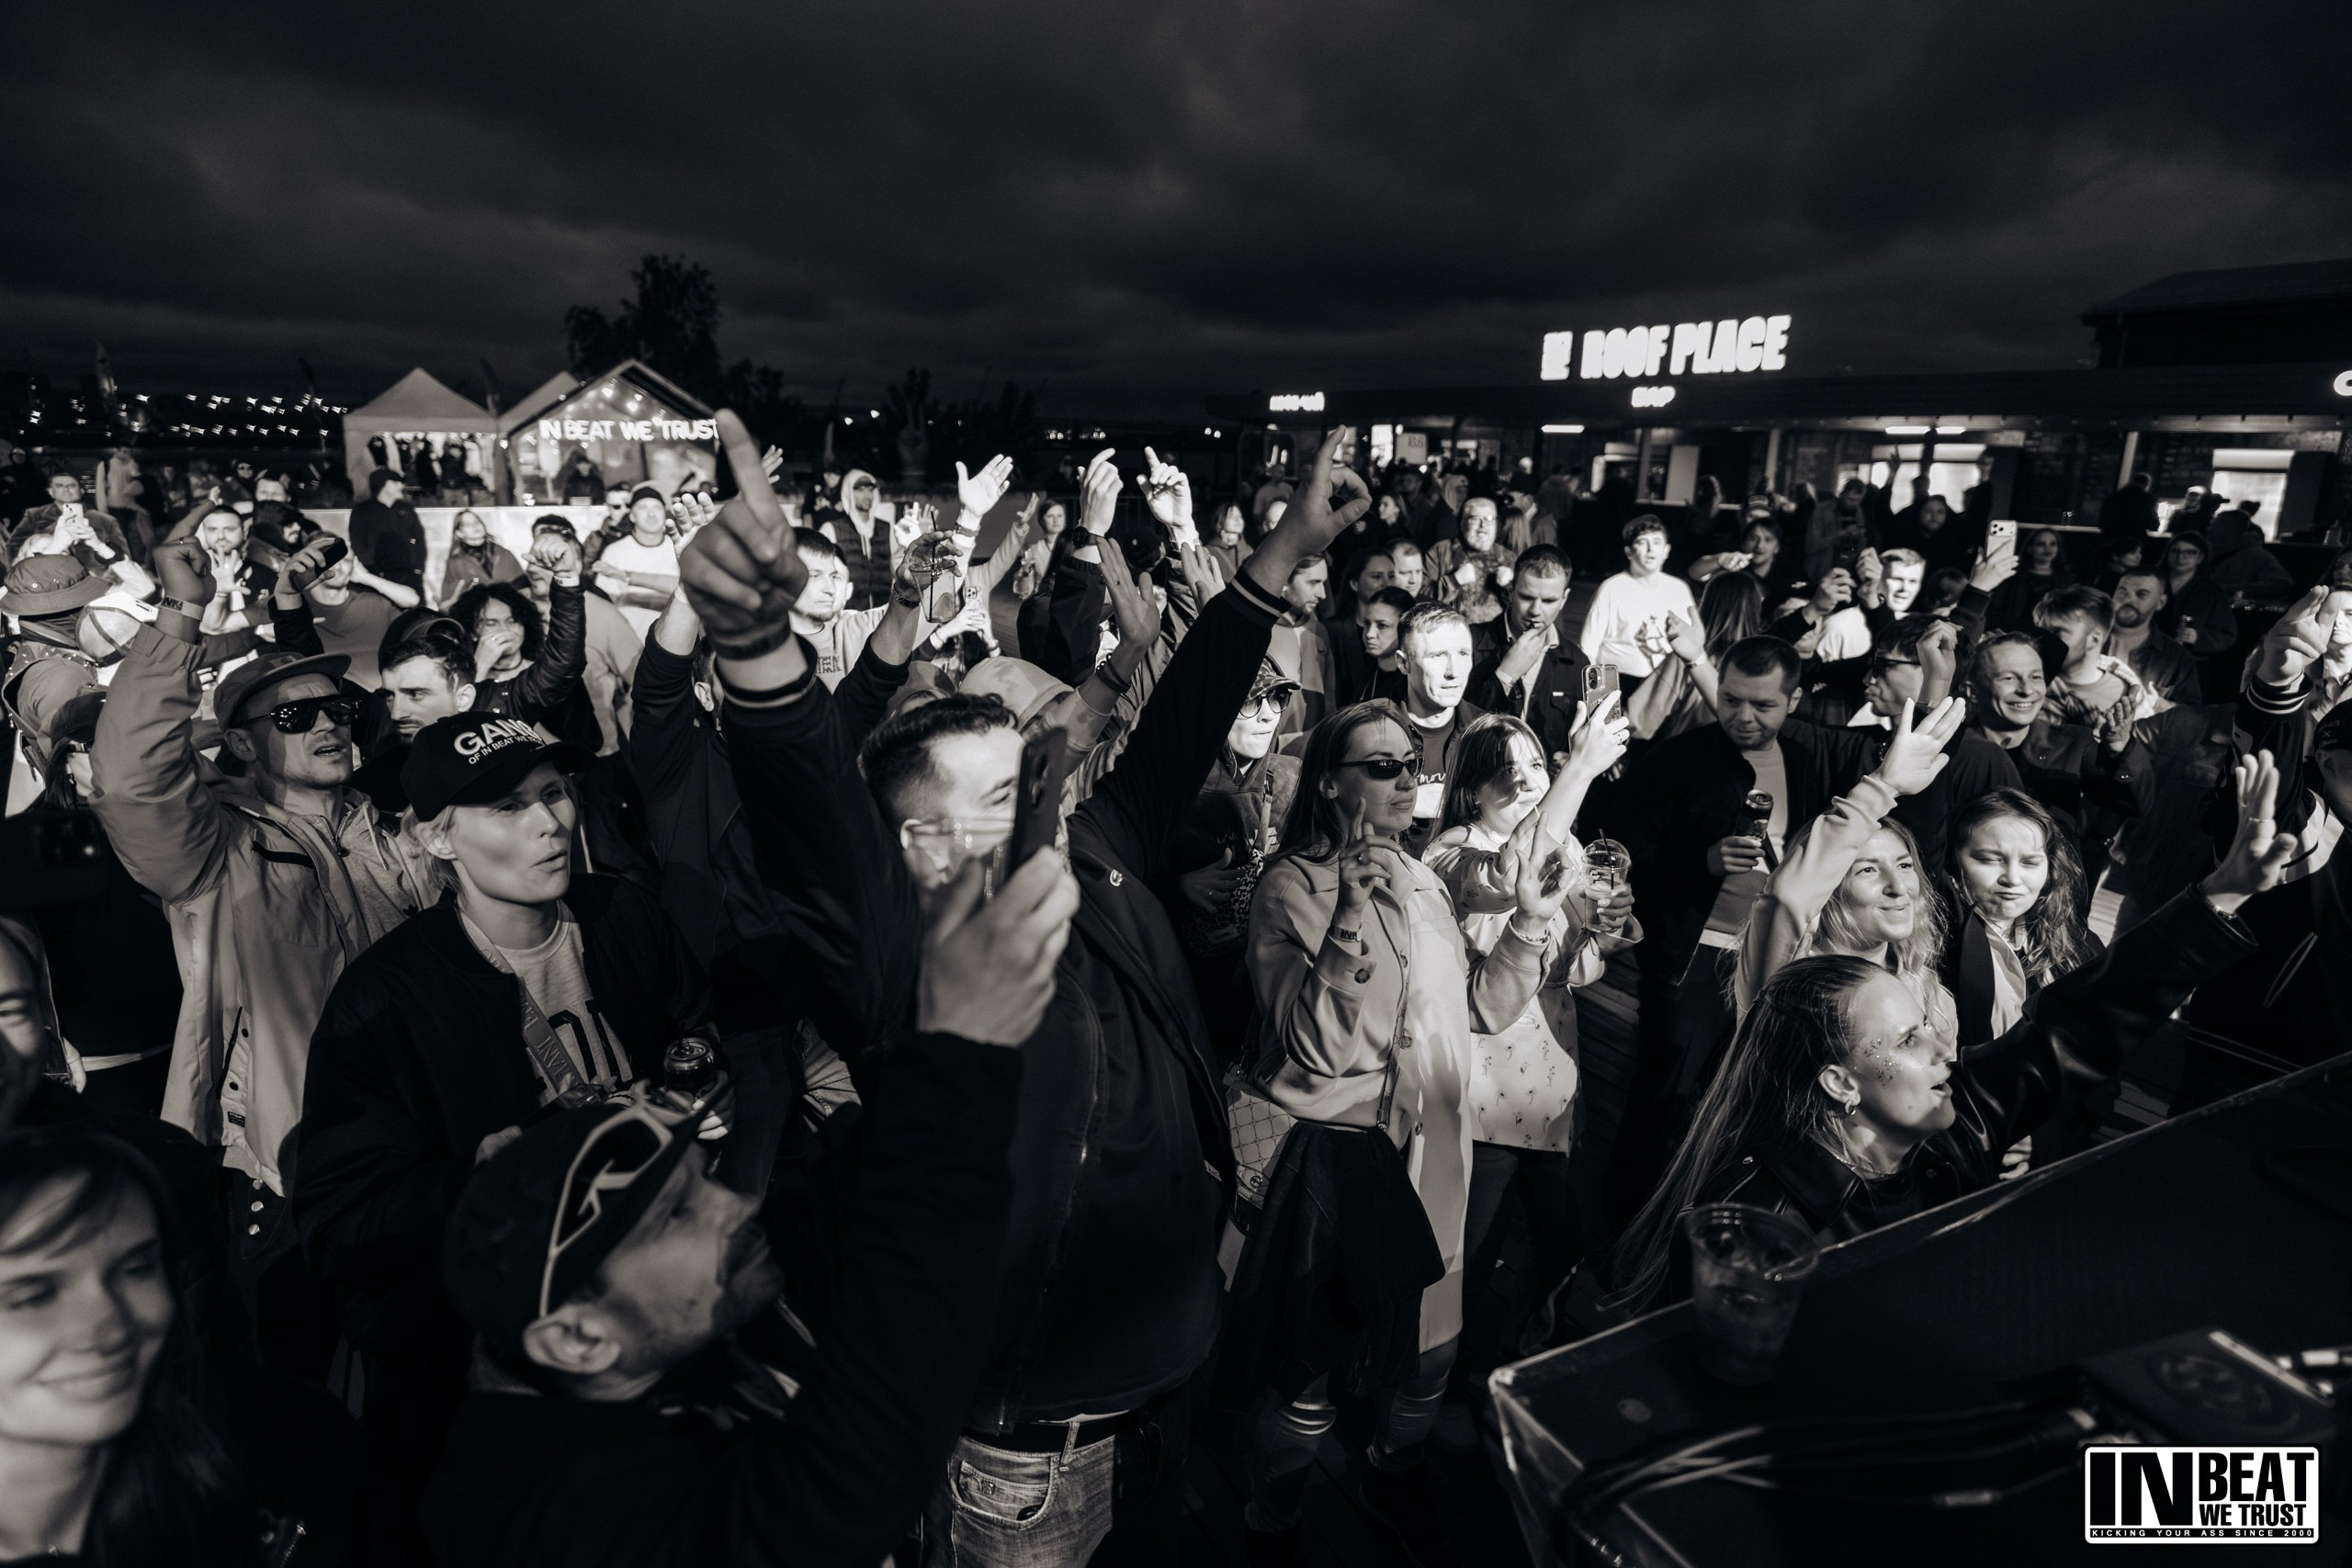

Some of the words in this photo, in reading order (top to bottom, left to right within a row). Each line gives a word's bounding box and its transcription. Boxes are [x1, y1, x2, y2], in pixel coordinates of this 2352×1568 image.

[1669, 315, 1792, 375] PLACE
[538, 419, 561, 439] IN
[563, 420, 615, 440] BEAT
[619, 421, 654, 441] WE
[661, 419, 719, 440] TRUST
[469, 752, 481, 764] OF
[481, 746, 492, 756] IN
[492, 737, 514, 750] BEAT
